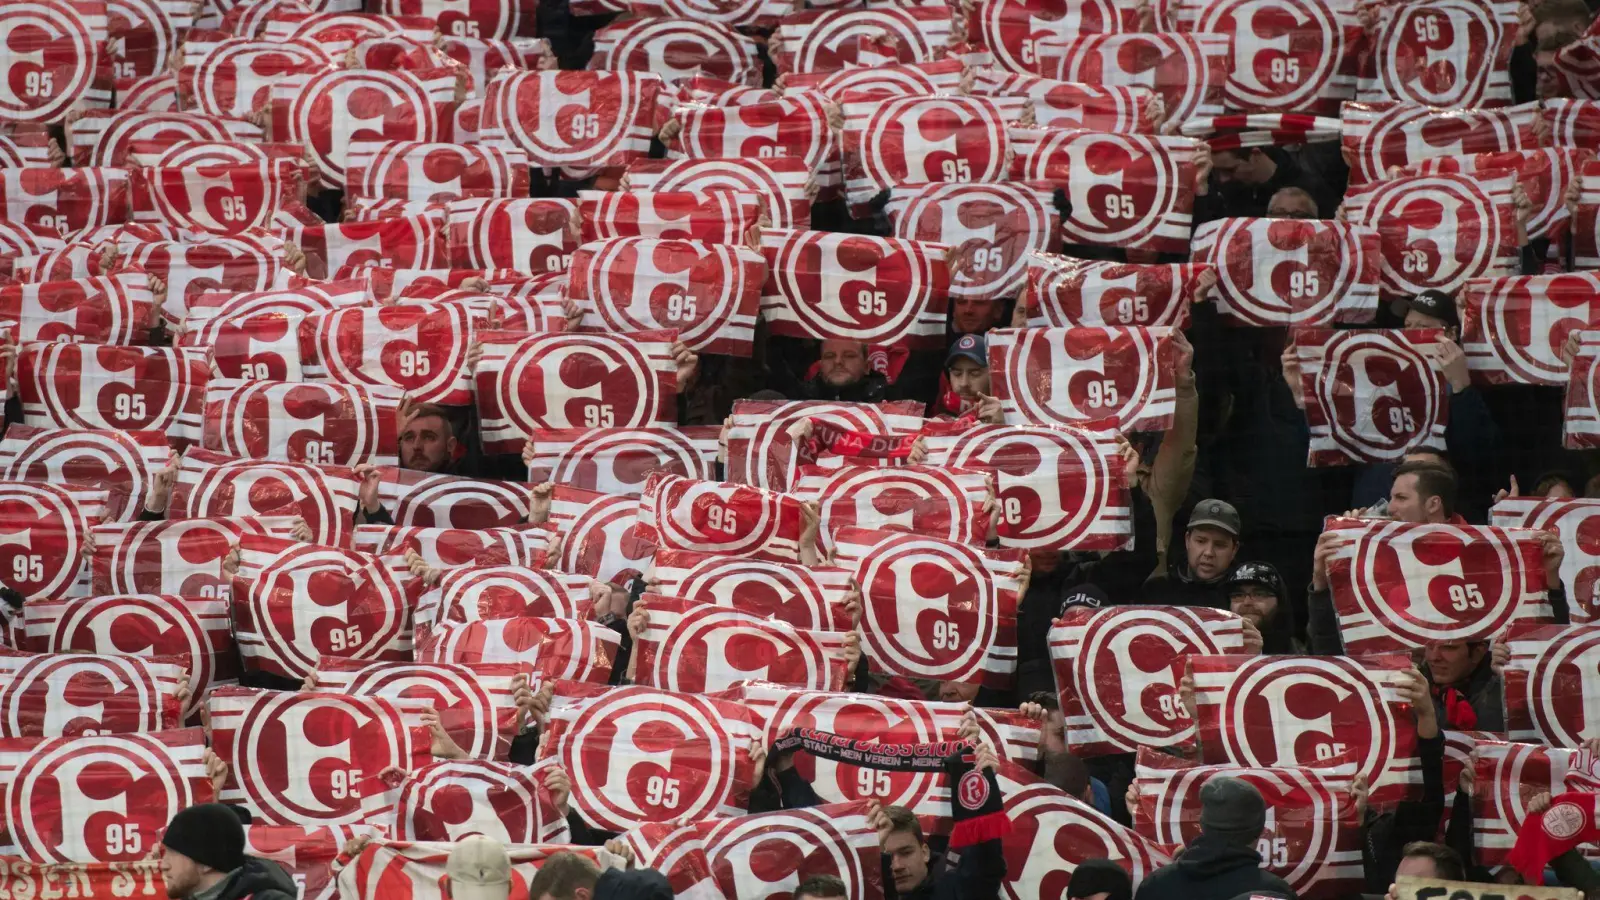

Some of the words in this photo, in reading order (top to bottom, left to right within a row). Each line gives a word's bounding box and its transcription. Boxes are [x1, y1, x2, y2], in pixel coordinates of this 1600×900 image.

[25, 71, 54, 97] 95
[1271, 58, 1300, 84] 95
[571, 113, 599, 139] 95
[942, 159, 971, 183] 95
[220, 196, 247, 222] 95
[1105, 194, 1135, 219] 95
[972, 247, 1003, 272] 95
[1290, 271, 1319, 298] 95
[666, 294, 696, 321] 95
[858, 290, 887, 316] 95
[1117, 296, 1148, 323] 95
[400, 351, 430, 377] 95
[115, 393, 146, 421] 95
[1088, 380, 1118, 408] 95
[585, 405, 615, 428] 95
[1389, 407, 1415, 433] 95
[306, 441, 334, 465] 95
[708, 504, 738, 535] 95
[13, 555, 44, 582] 95
[1448, 584, 1484, 612] 95
[331, 625, 362, 652] 95
[933, 620, 960, 651] 95
[1159, 694, 1191, 720] 95
[803, 739, 834, 754] STADT
[840, 748, 863, 761] MEIN
[864, 753, 901, 767] VEREIN
[331, 769, 363, 799] 95
[646, 776, 680, 809] 95
[858, 768, 891, 797] 95
[106, 824, 142, 855] 95
